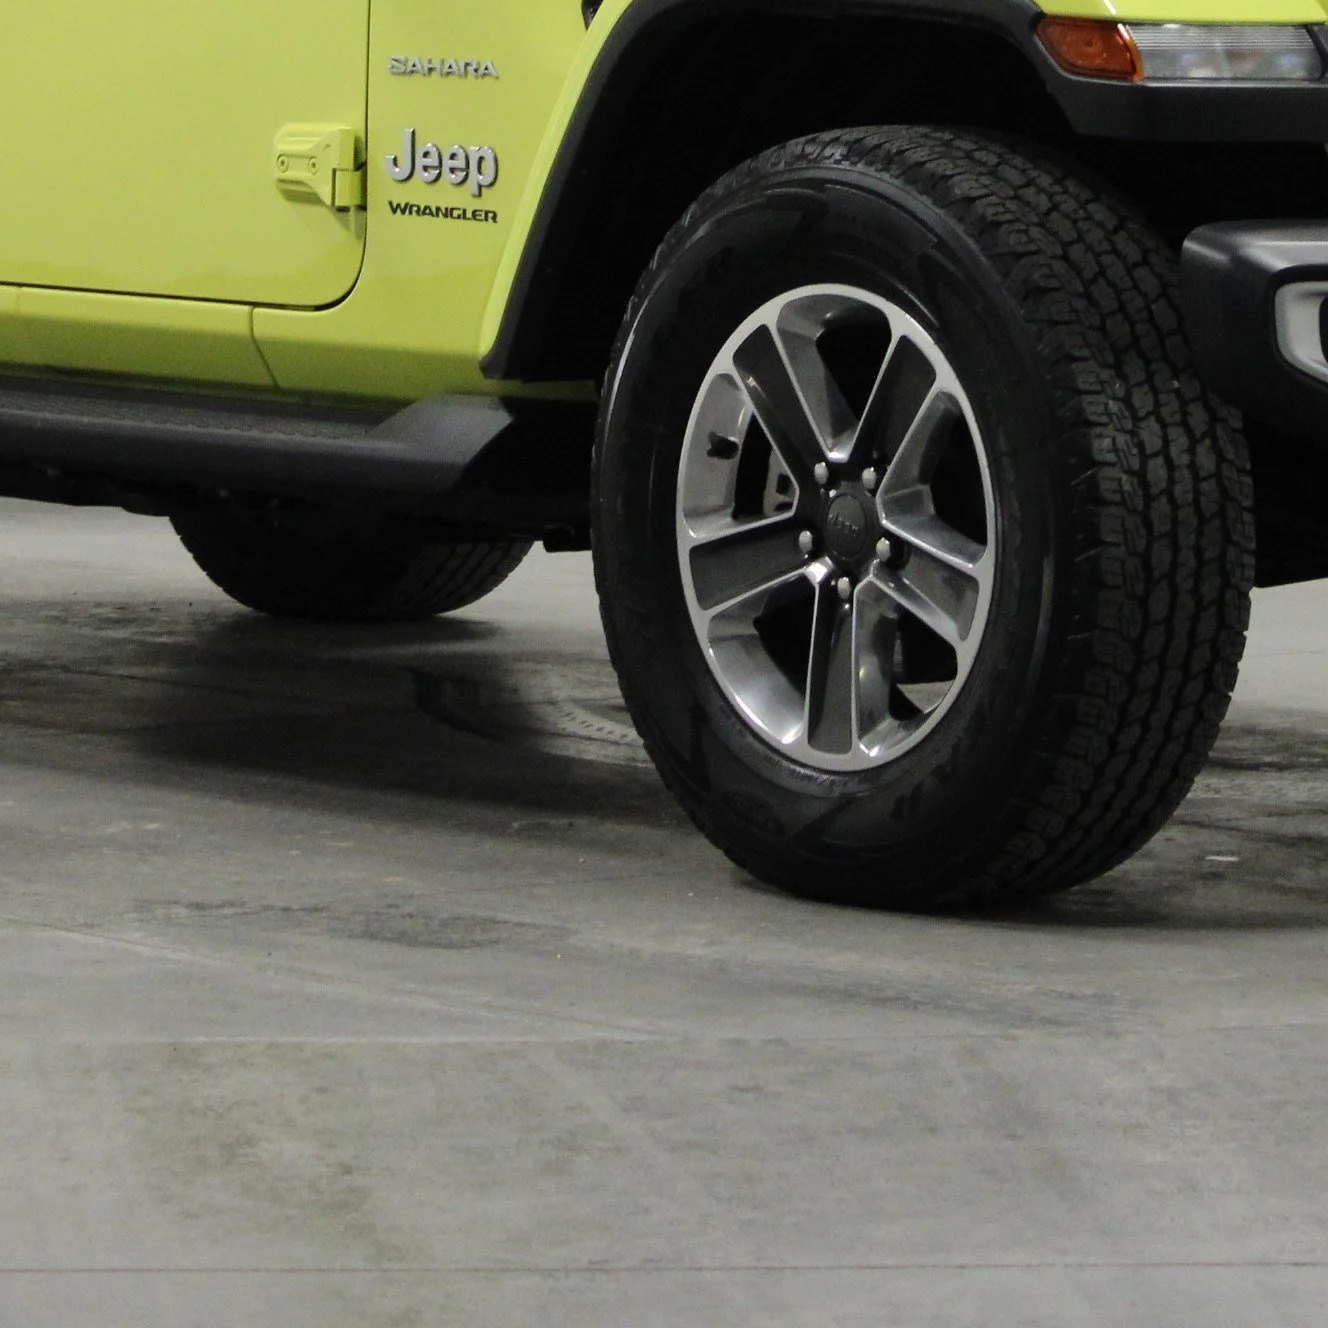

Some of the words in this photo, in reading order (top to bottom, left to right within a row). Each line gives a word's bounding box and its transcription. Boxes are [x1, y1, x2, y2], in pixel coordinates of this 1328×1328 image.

[387, 55, 500, 79] SAHARA
[385, 127, 499, 198] Jeep
[387, 199, 499, 224] WRANGLER
